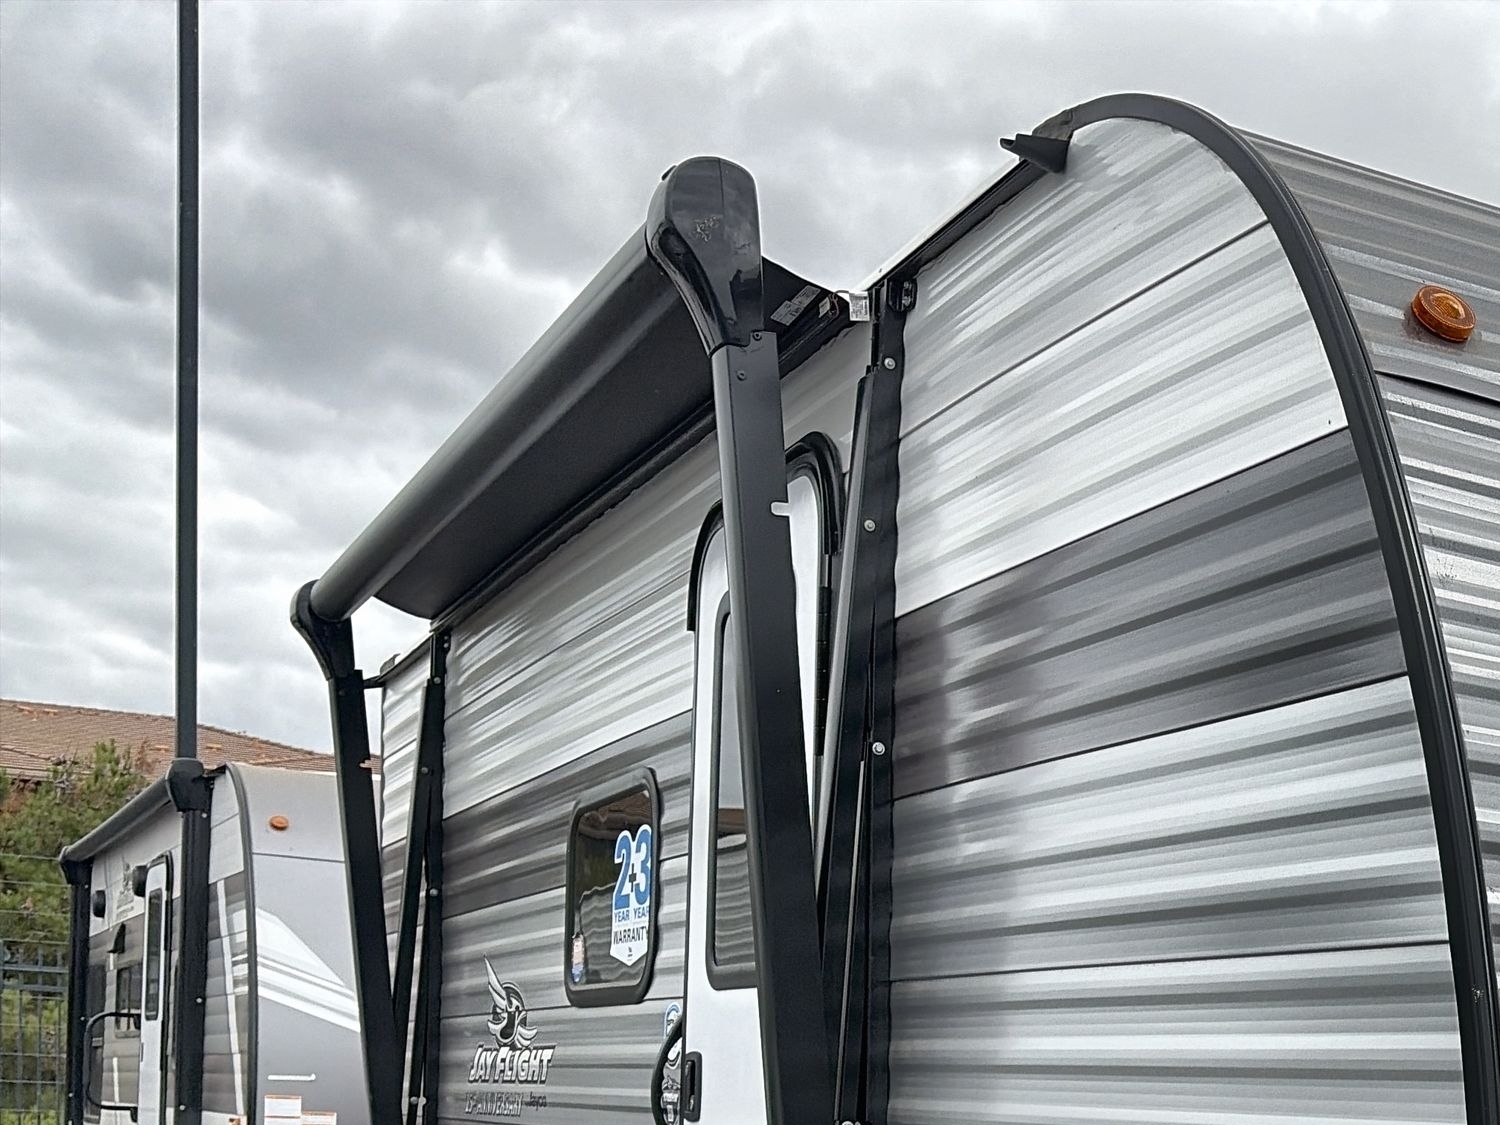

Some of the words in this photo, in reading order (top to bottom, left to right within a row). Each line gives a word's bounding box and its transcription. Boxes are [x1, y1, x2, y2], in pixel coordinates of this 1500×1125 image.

[614, 910, 630, 923] YEAR
[468, 1043, 499, 1083] JAY
[493, 1045, 556, 1084] FLIGHT
